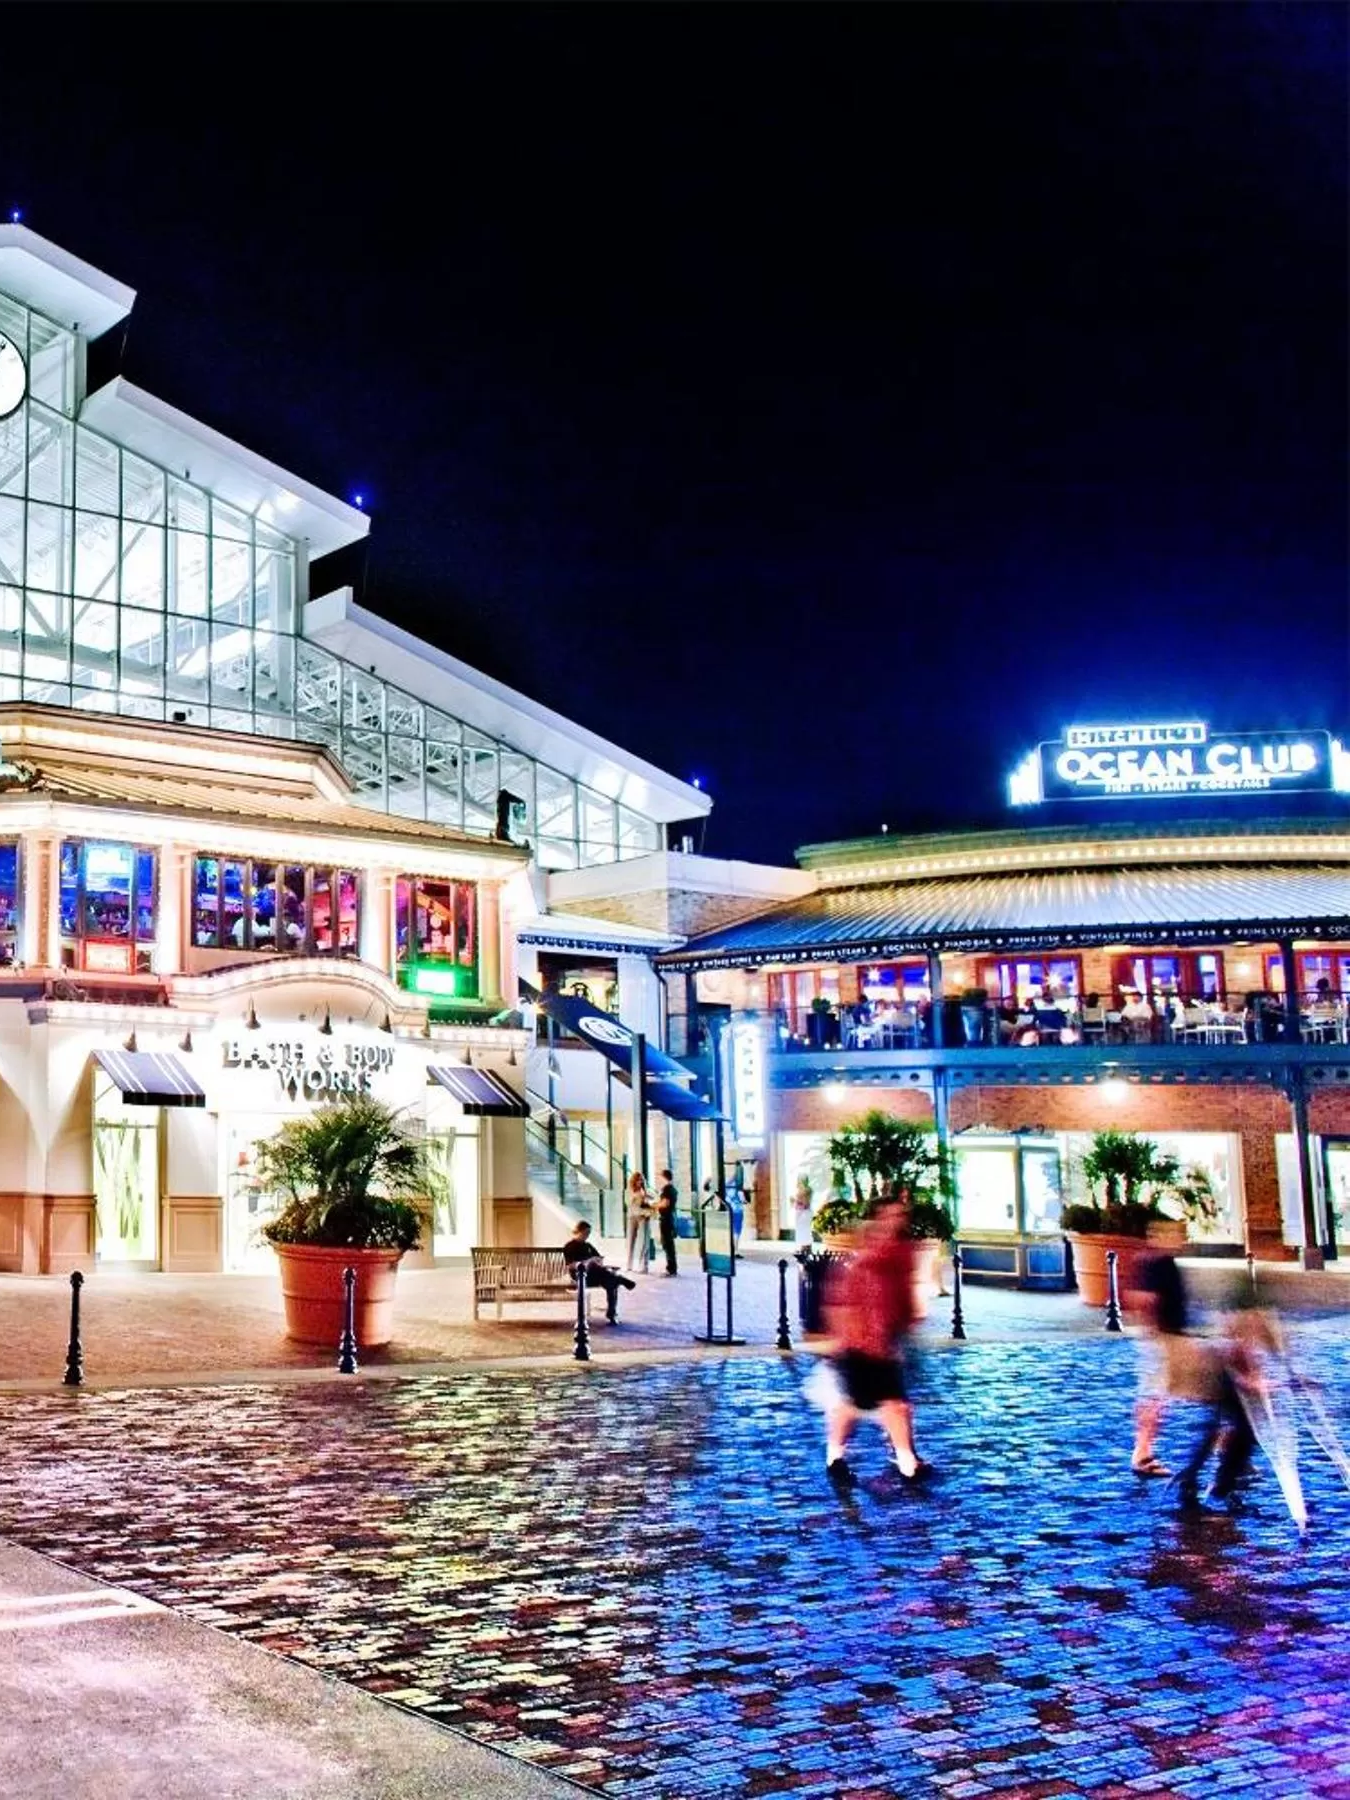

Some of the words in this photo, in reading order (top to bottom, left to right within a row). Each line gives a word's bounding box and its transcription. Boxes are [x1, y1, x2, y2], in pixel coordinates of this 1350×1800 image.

[1056, 748, 1195, 781] OCEAN
[1205, 743, 1317, 776] CLUB
[221, 1041, 305, 1069] BATH
[316, 1043, 335, 1068] &
[344, 1043, 394, 1072] BODY
[277, 1066, 372, 1097] WORKS
